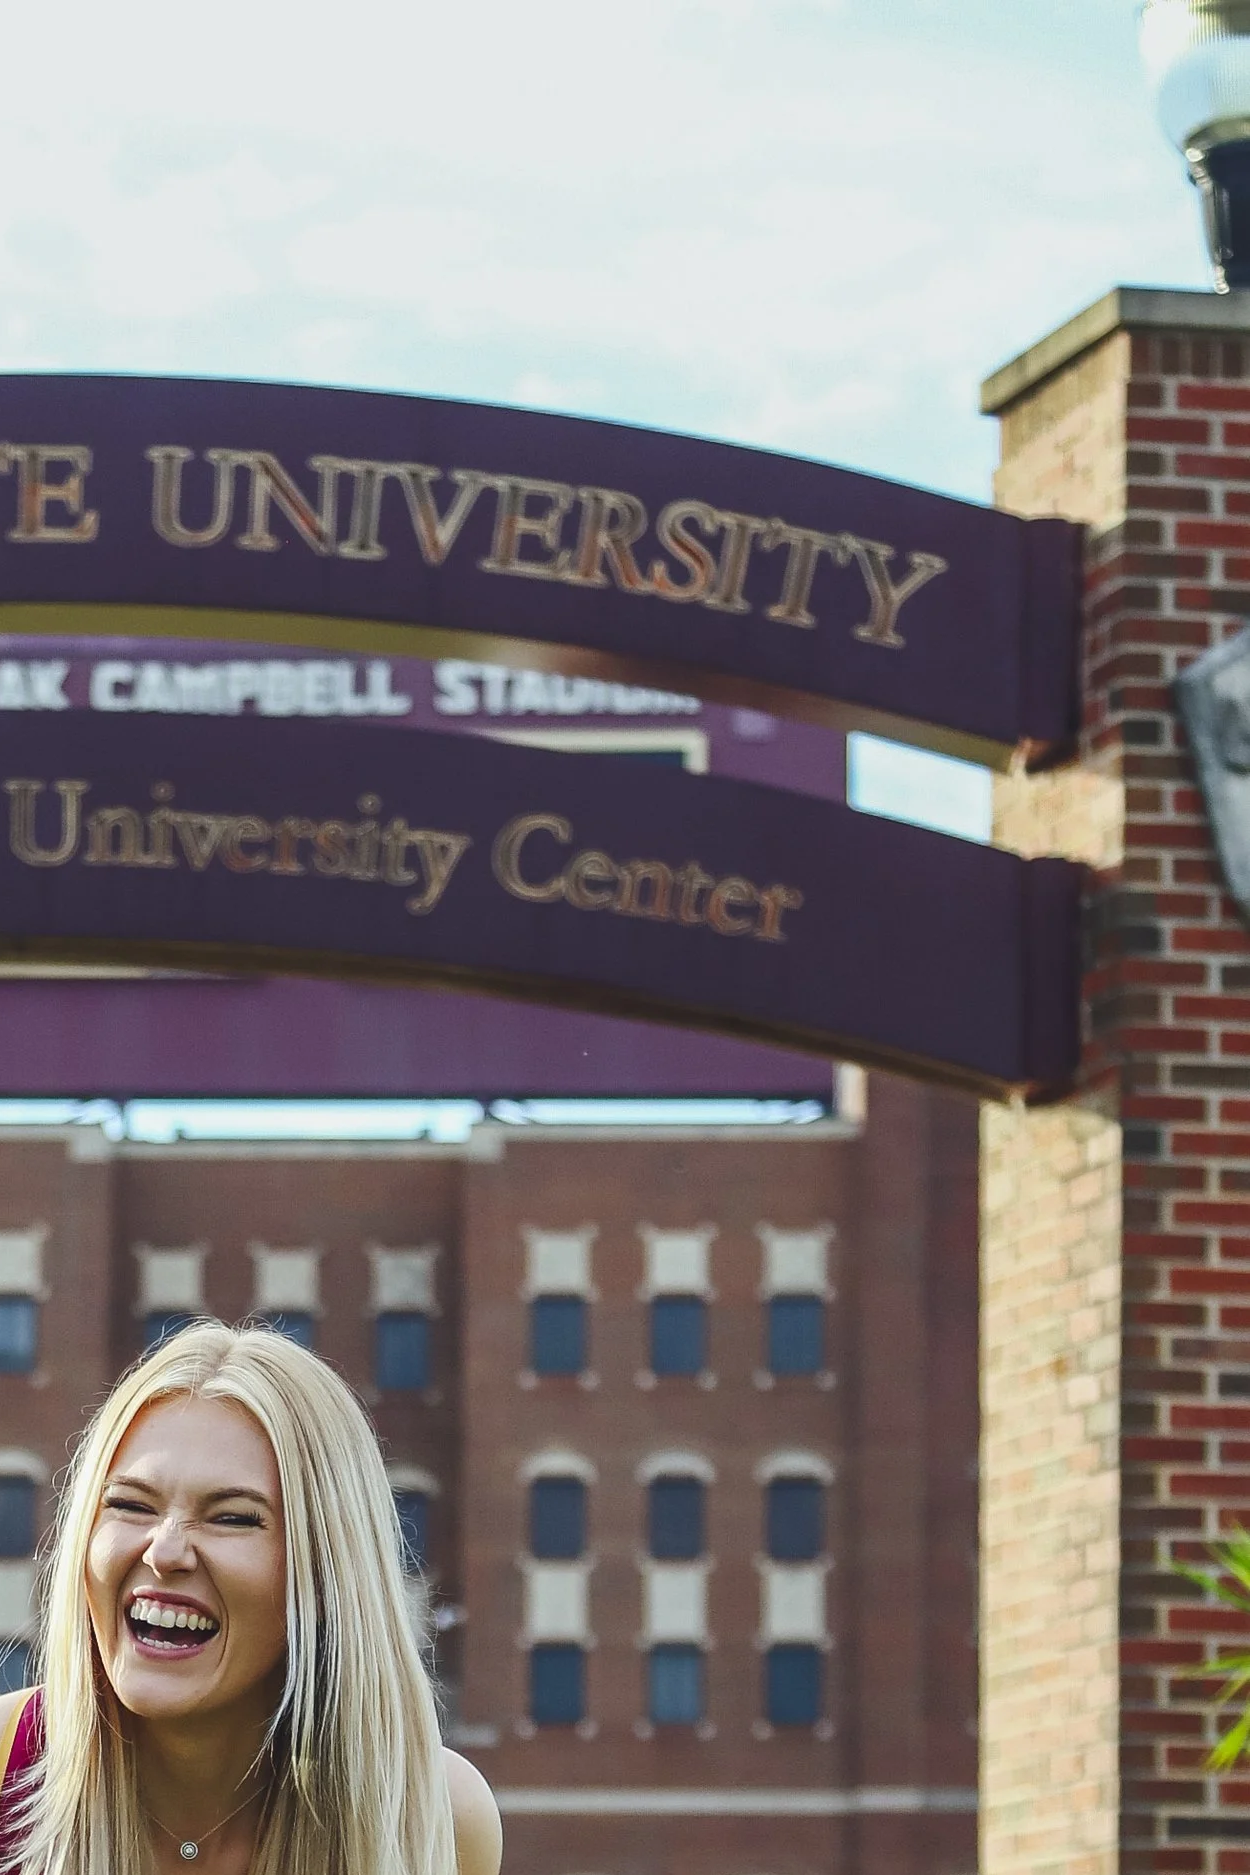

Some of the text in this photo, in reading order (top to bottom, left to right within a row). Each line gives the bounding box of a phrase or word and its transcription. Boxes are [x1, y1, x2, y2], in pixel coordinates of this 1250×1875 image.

[147, 444, 948, 648] UNIVERSITY
[90, 659, 413, 717] CAMPBELL
[4, 778, 472, 915] University
[492, 811, 803, 943] Center
